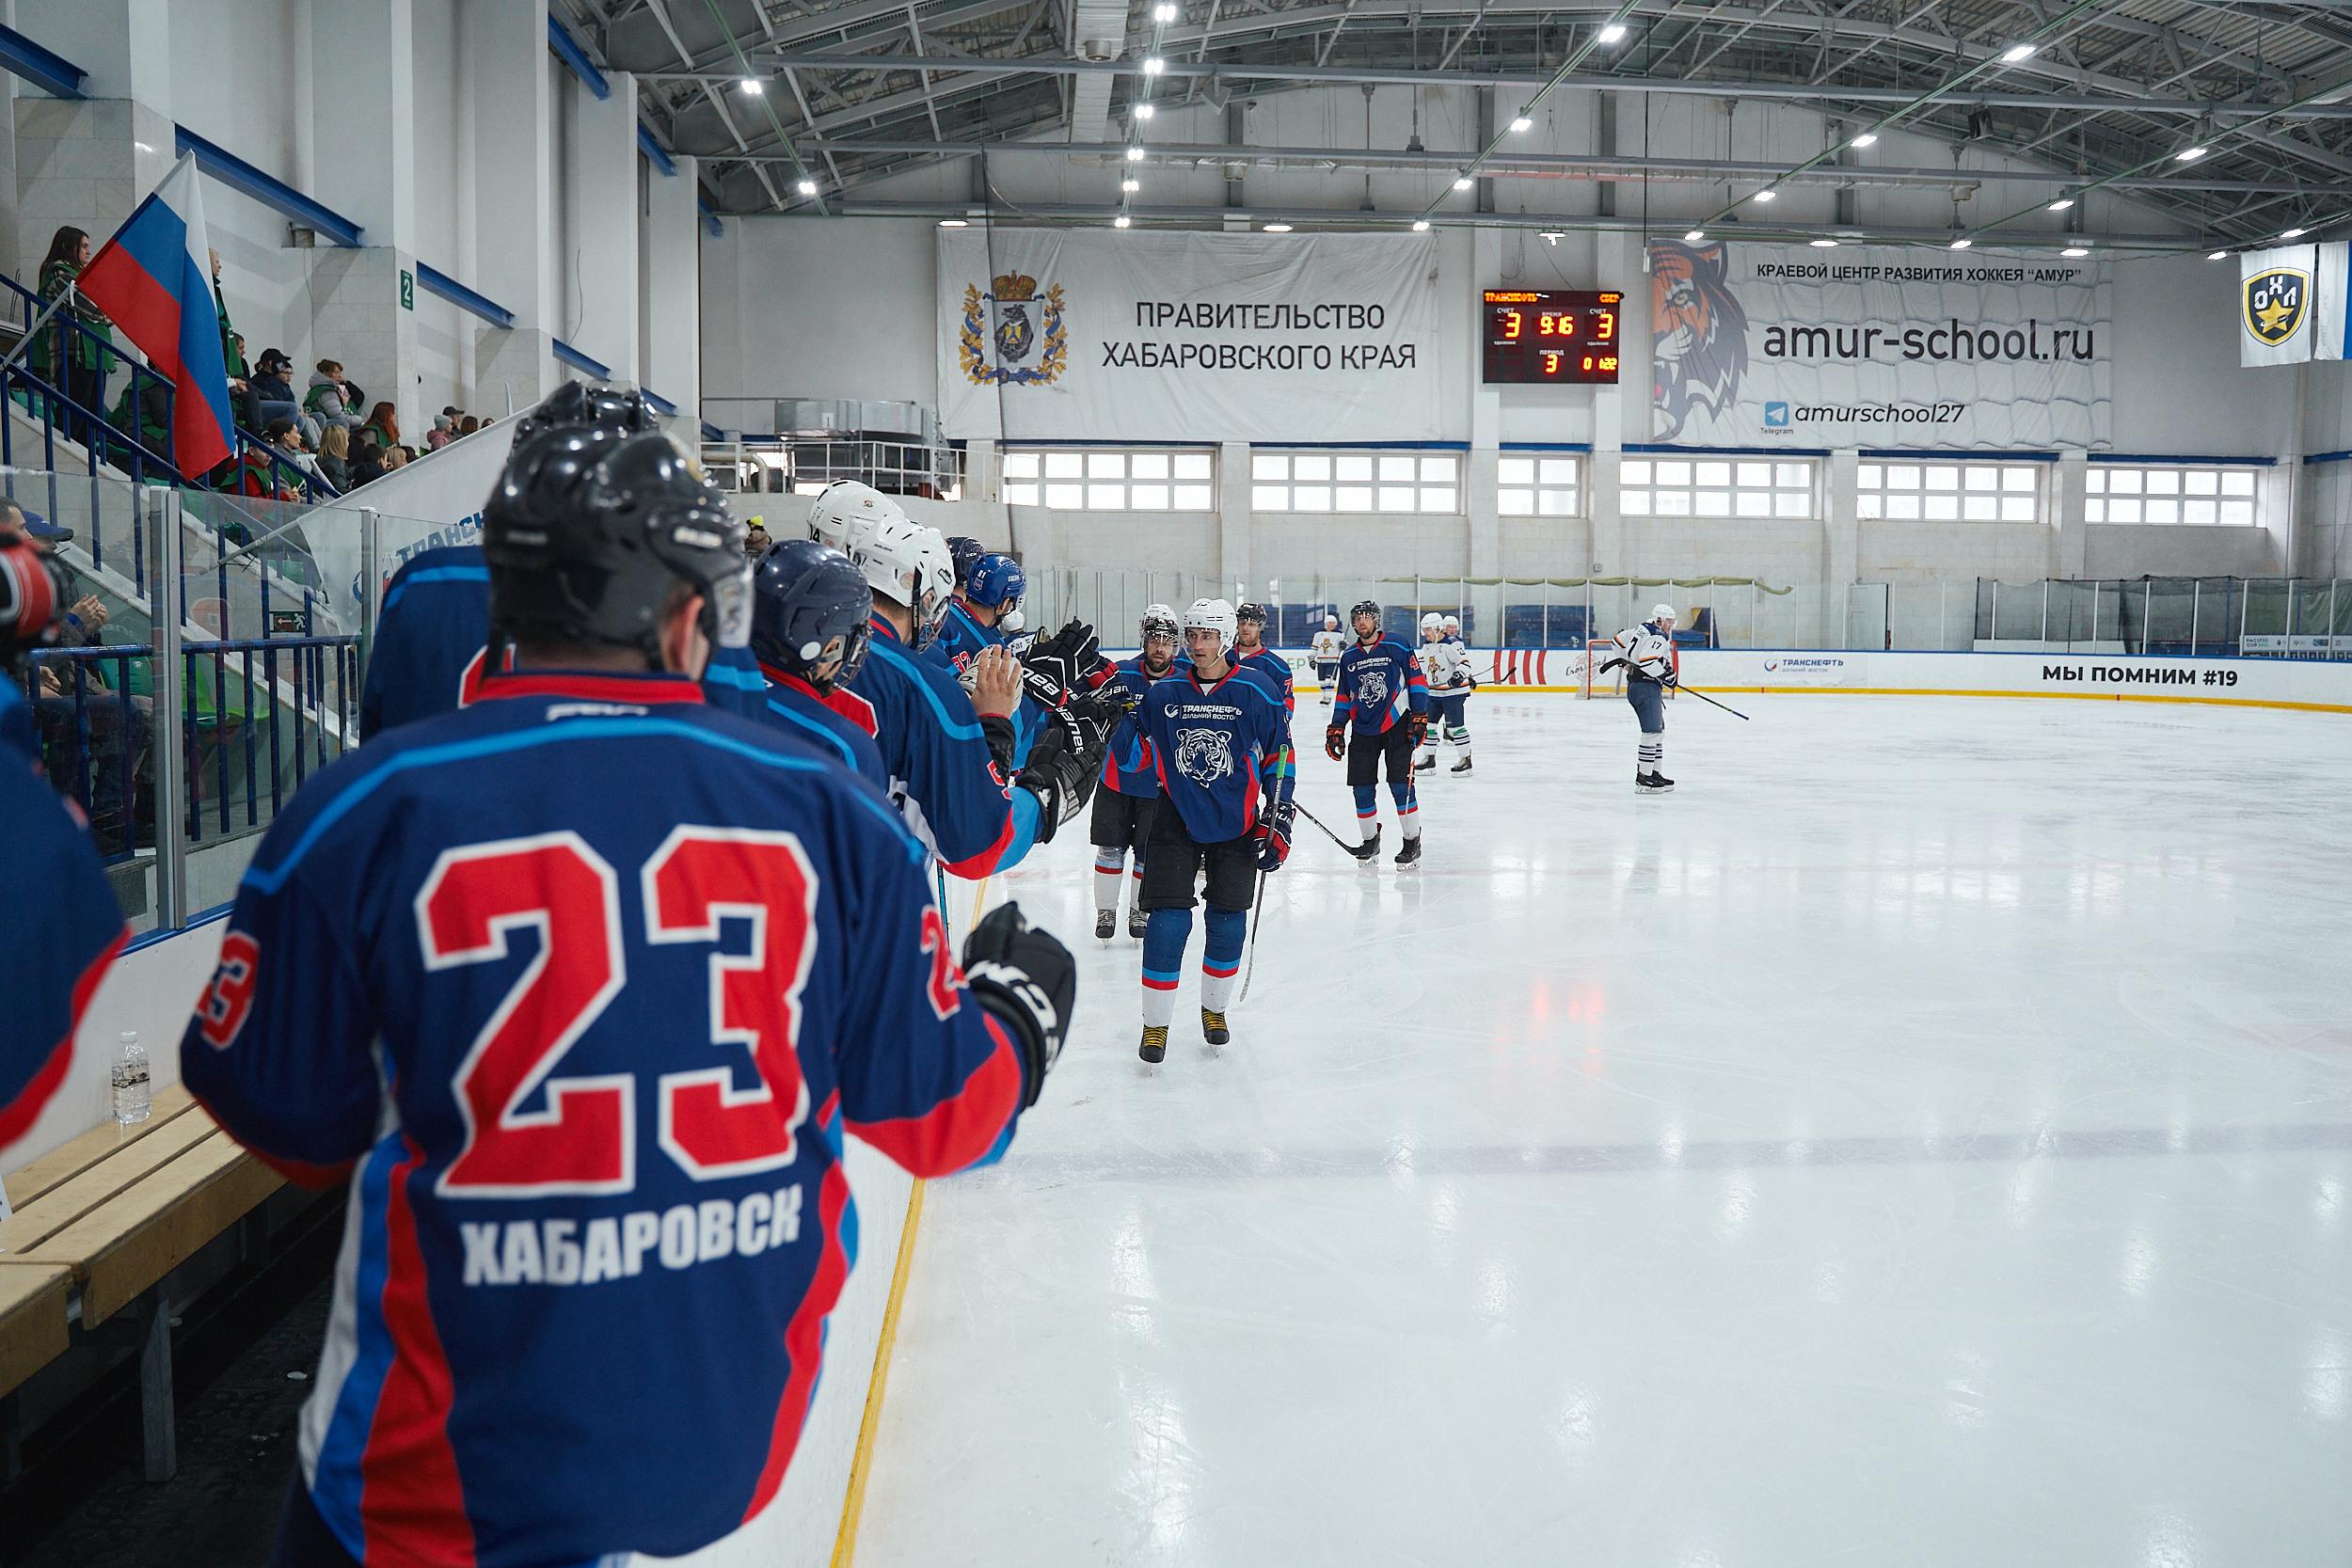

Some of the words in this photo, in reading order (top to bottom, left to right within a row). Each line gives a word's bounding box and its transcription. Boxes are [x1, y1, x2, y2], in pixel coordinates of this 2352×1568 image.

[1757, 263, 1828, 278] КРАЕВОЙ
[1832, 266, 1881, 281] ЦЕНТР
[1884, 267, 1963, 280] РАЗВИТИЯ
[1966, 268, 2024, 281] ХОККЕЯ
[404, 277, 411, 301] 2
[1135, 302, 1386, 330] ПРАВИТЕЛЬСТВО
[1505, 312, 1521, 338] 3
[1597, 313, 1613, 339] 3
[1763, 318, 2094, 360] amur-school.ru
[1102, 341, 1331, 371] ХАБАРОВСКОГО
[1341, 343, 1417, 370] КРАЯ
[1546, 354, 1558, 373] 3
[1794, 404, 1965, 422] amurschool27
[1651, 641, 1662, 650] 17
[2042, 666, 2084, 681] МЫ
[2091, 667, 2196, 685] ПОМНИМ
[2202, 670, 2238, 687] #19
[1182, 705, 1243, 716] ТРАНСНЕФТЬ
[414, 821, 819, 1199] 23
[459, 1183, 803, 1286] ХАБАРОВСК
